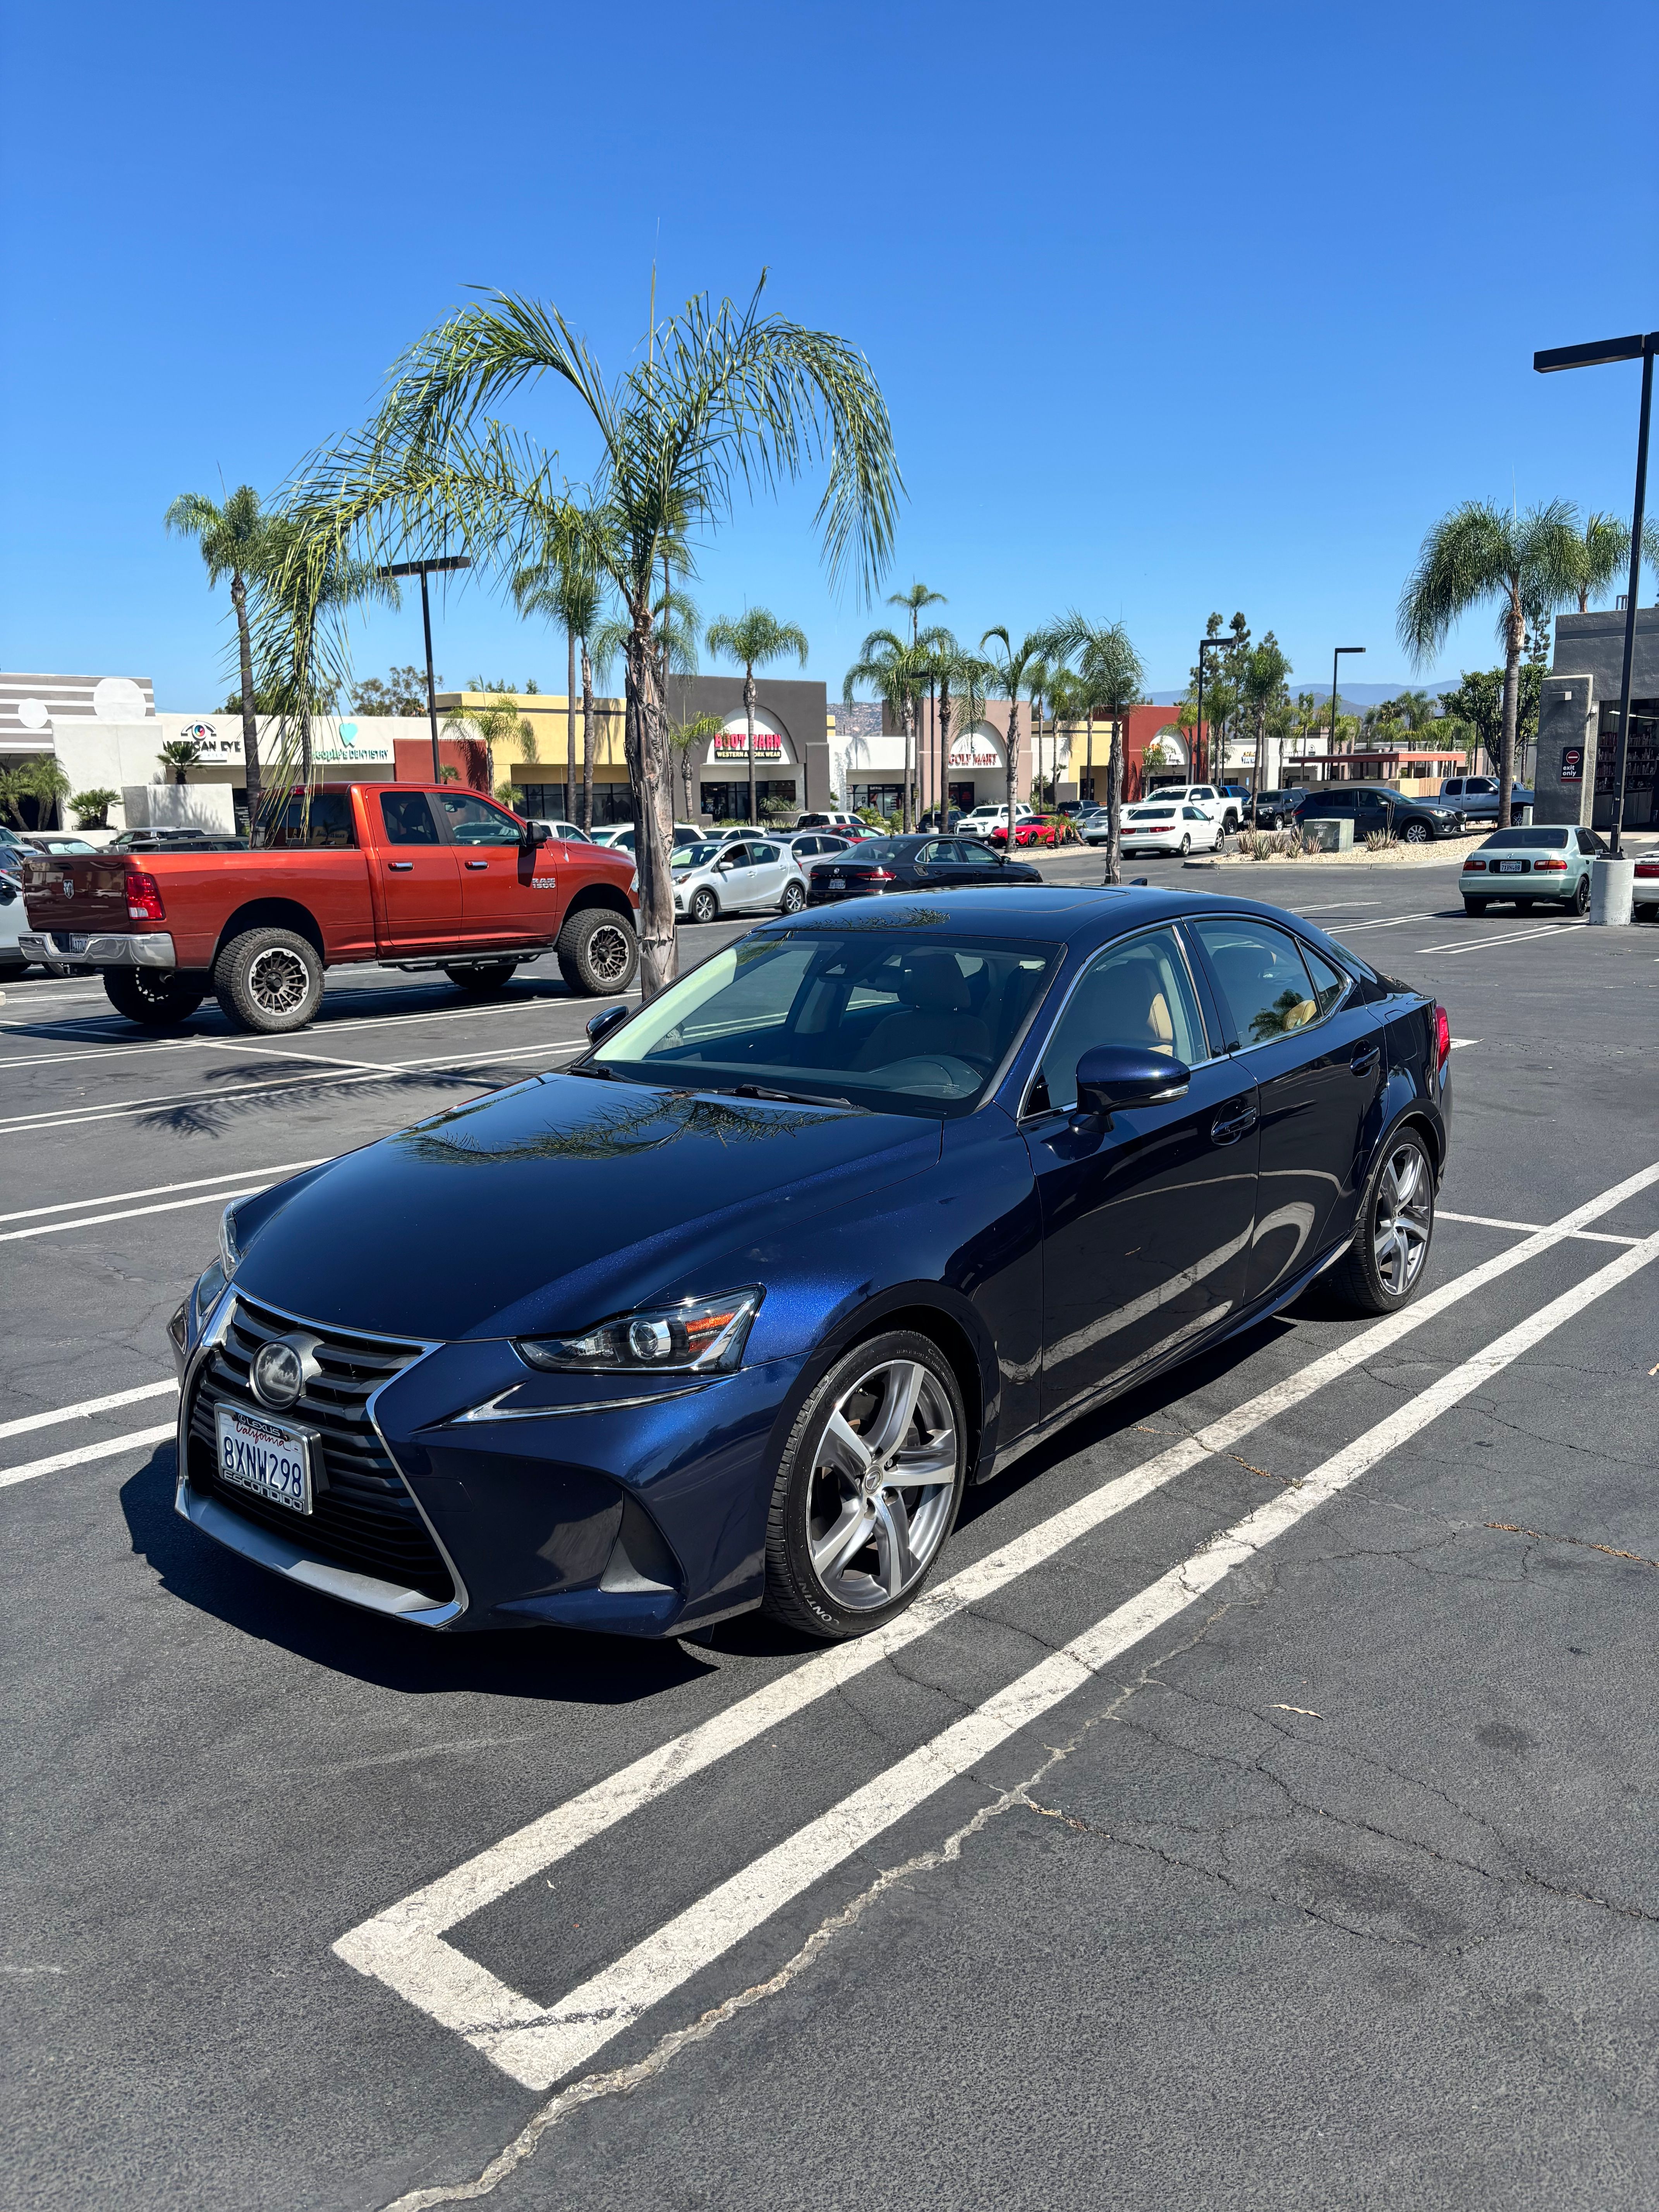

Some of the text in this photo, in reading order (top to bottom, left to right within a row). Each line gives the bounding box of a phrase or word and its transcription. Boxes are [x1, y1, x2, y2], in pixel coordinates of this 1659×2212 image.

[220, 741, 241, 752] EYE
[714, 734, 746, 748] BOOT
[348, 749, 388, 760] DENTISTRY
[949, 754, 998, 764] GOLF MART
[246, 1418, 281, 1437] LEXUS
[224, 1436, 302, 1498] 8XNW298
[224, 1470, 302, 1511] ESCONDIDO
